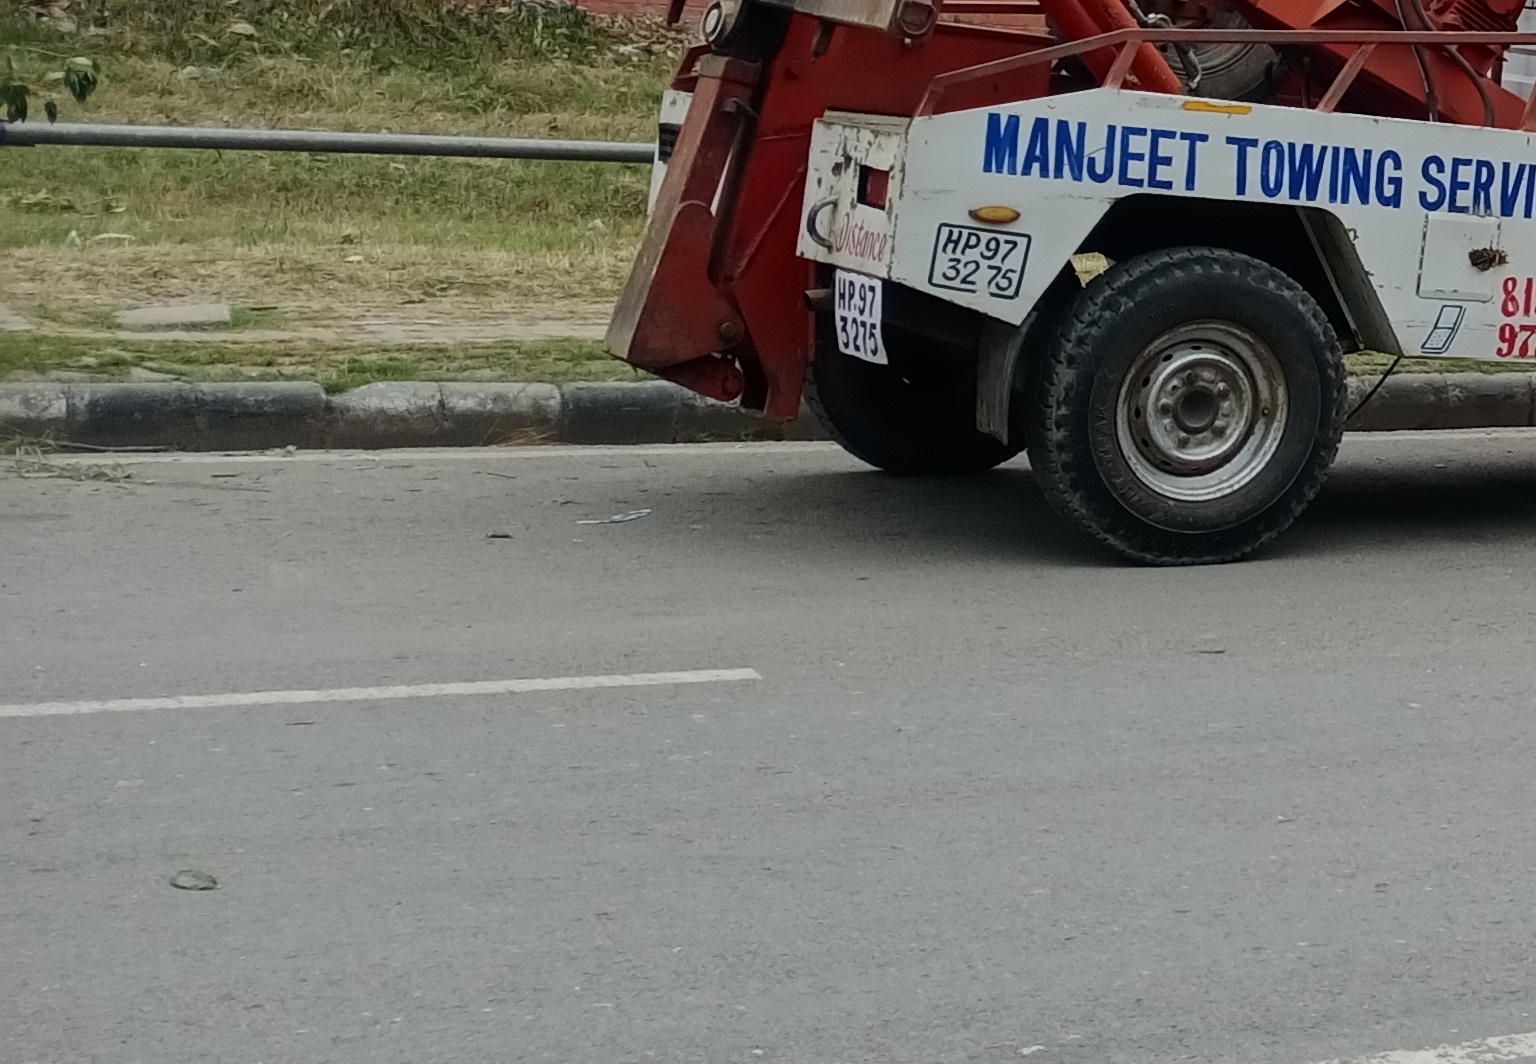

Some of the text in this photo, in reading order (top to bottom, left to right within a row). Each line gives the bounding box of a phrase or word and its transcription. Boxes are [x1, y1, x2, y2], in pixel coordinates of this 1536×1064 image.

[982, 112, 1209, 191] MANJEET
[1225, 135, 1403, 209] TOWING
[839, 315, 878, 357] 3275
